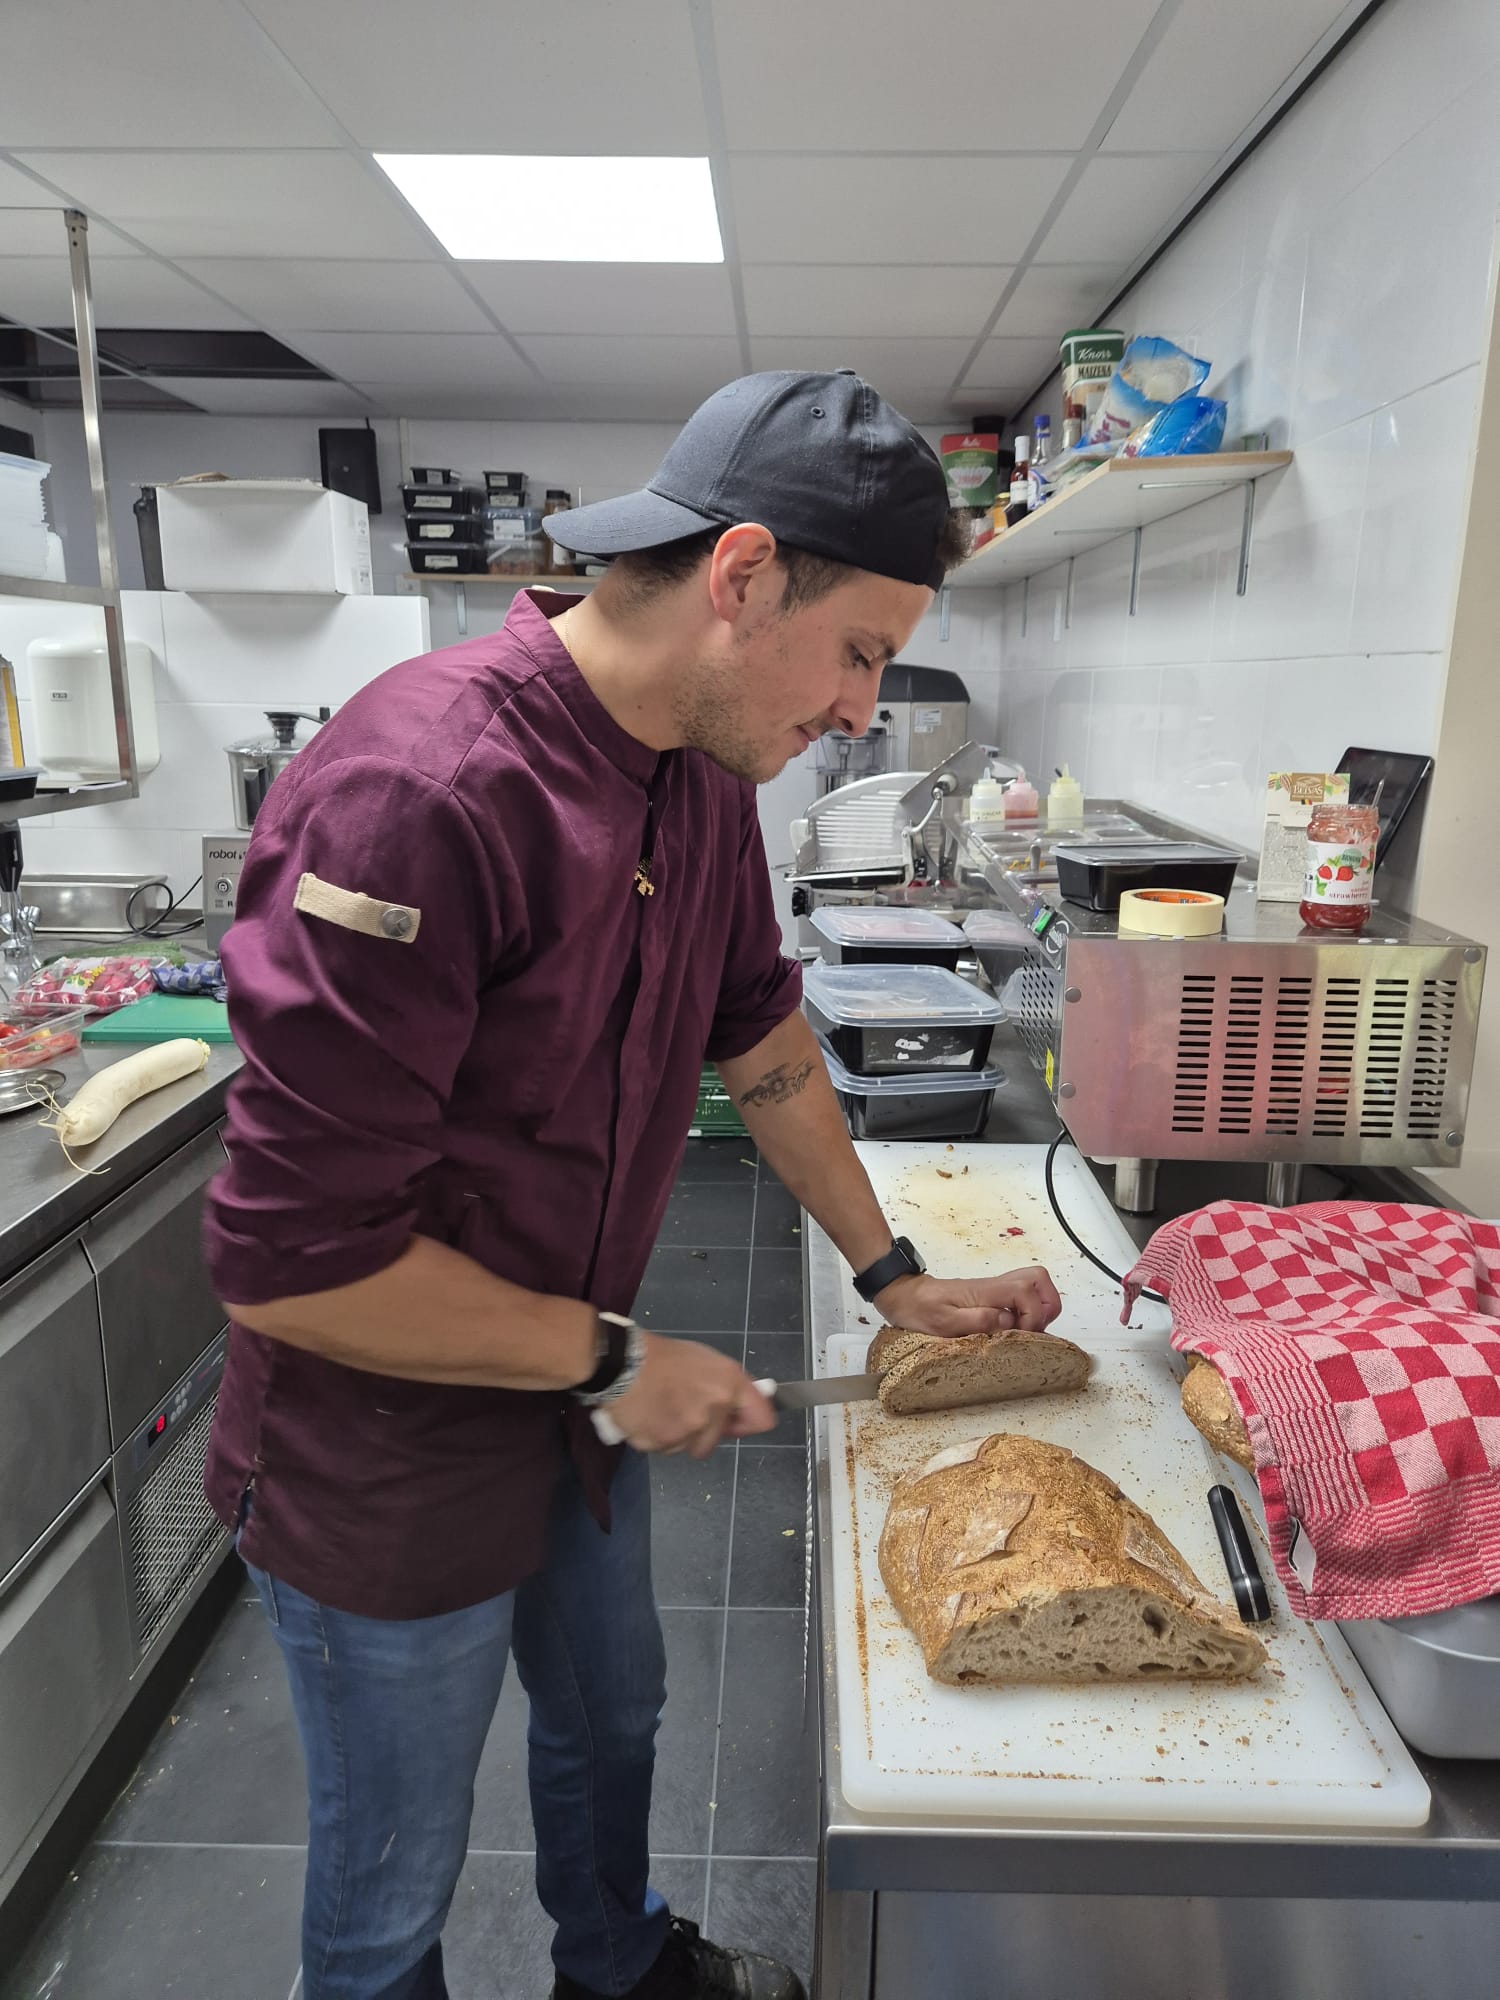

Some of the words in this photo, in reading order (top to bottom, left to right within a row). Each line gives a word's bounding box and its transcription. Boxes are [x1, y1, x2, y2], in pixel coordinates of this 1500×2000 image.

[1078, 347, 1112, 360] Knorr
[1078, 364, 1112, 377] MAIZENA
[209, 849, 237, 859] robot
